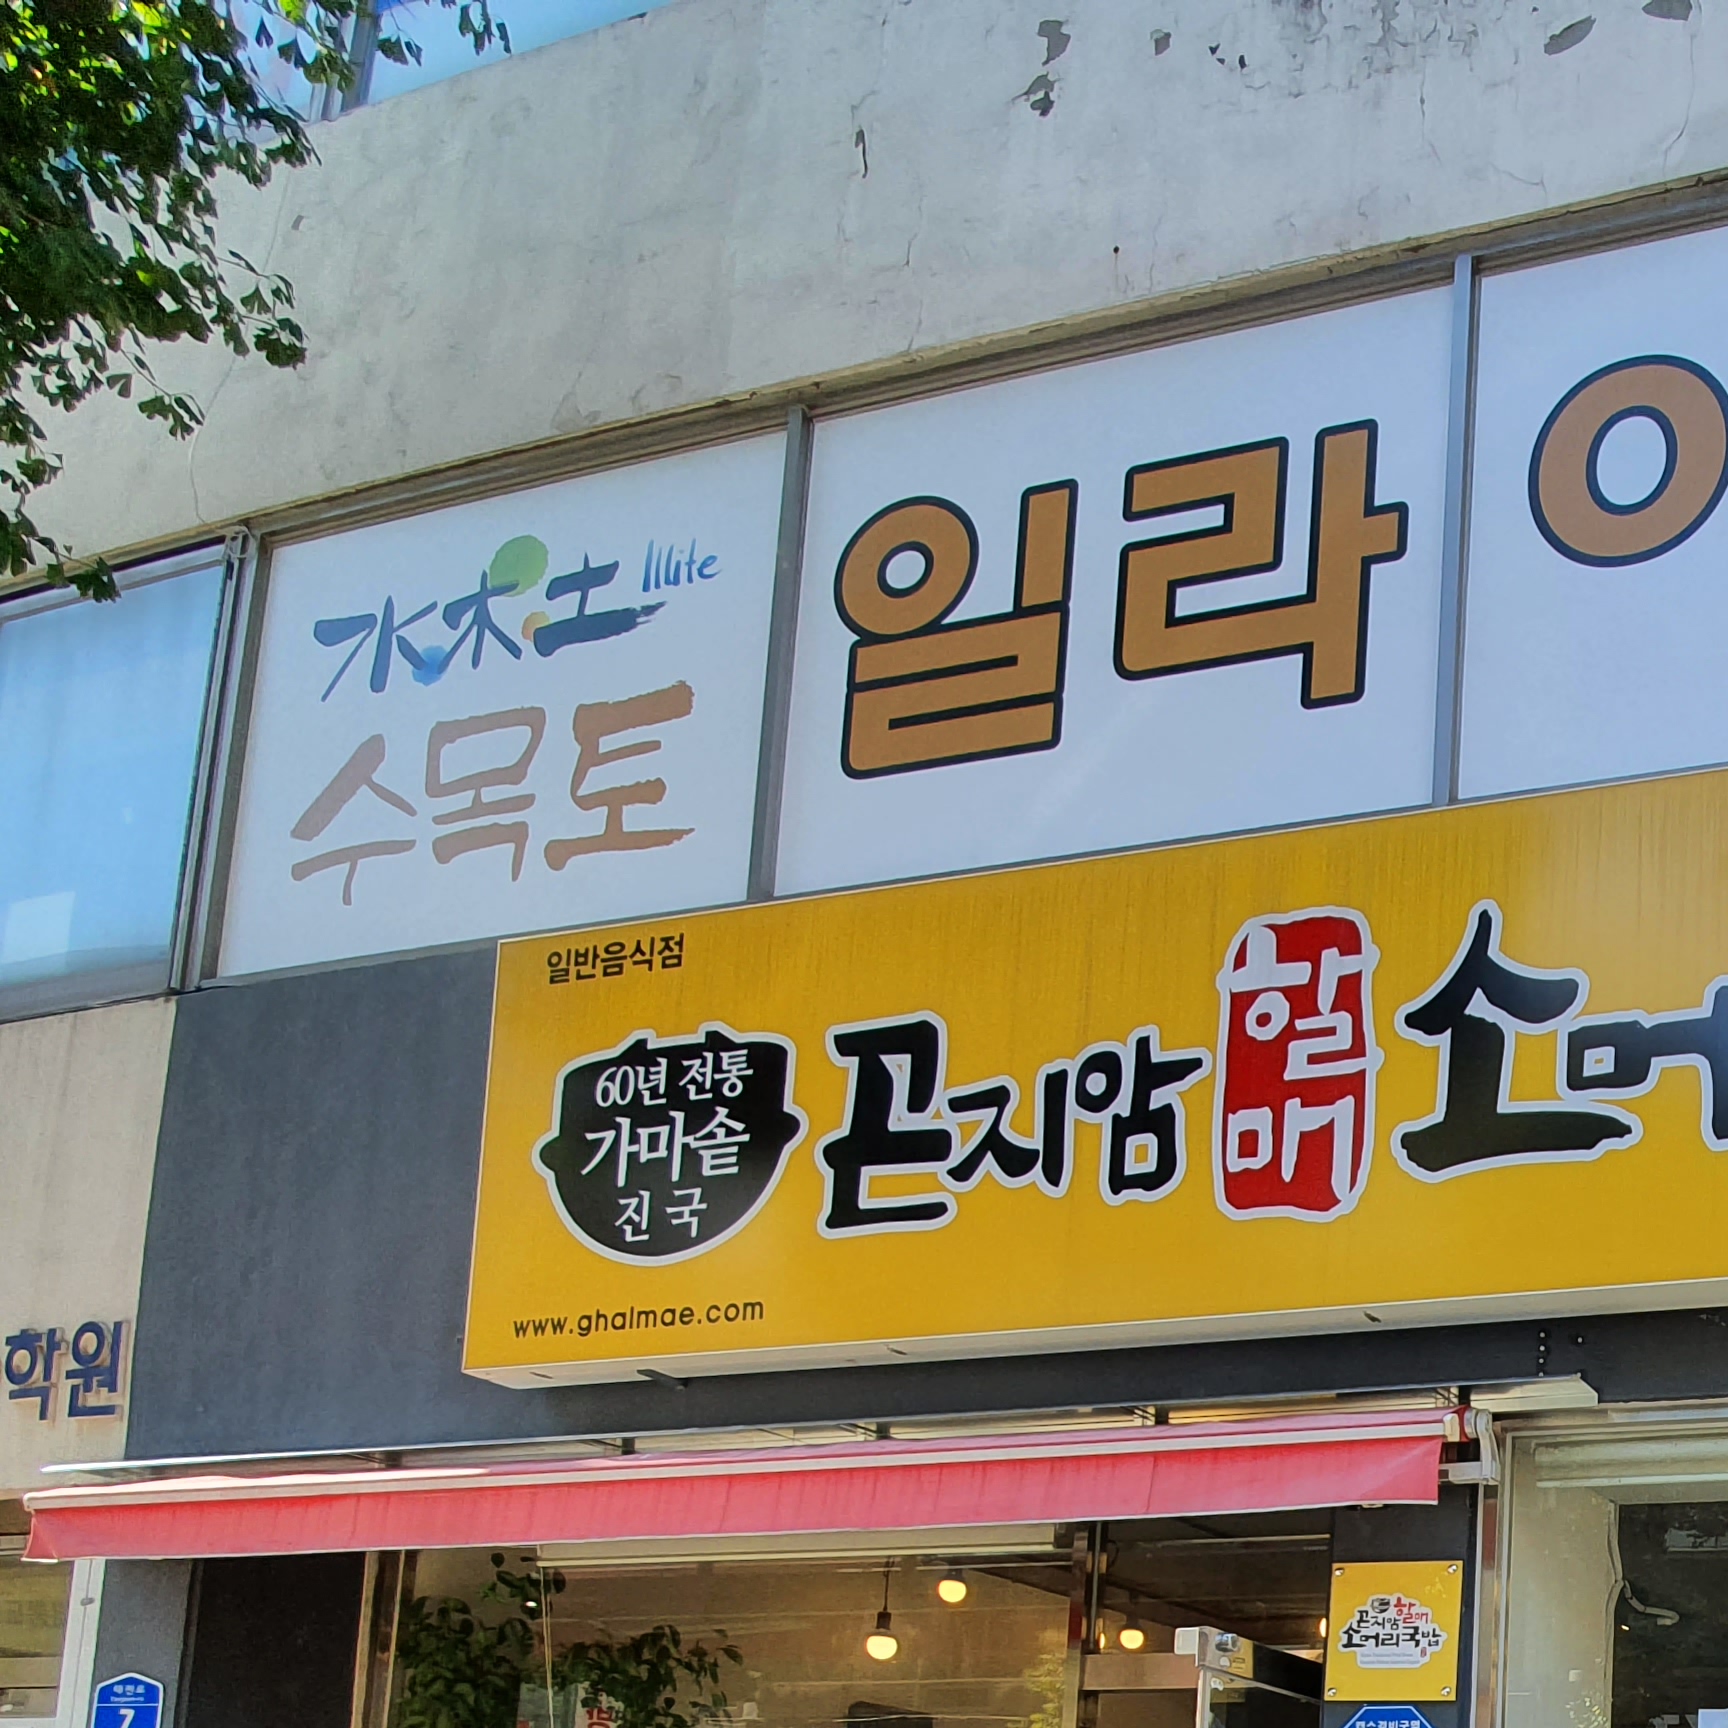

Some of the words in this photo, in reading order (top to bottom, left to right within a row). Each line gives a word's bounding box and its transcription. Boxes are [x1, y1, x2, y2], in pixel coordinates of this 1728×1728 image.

[289, 679, 697, 907] 수목토
[546, 932, 687, 987] 일반음식점
[594, 1054, 669, 1107] 60년
[679, 1045, 754, 1102] 전통
[818, 1016, 1206, 1232] 곤지암
[1222, 913, 1378, 1208] 할매
[580, 1106, 752, 1190] 가마솥
[512, 1296, 766, 1340] www.ghalmae.com
[4, 1319, 124, 1422] 학원
[1341, 1621, 1443, 1649] 소머리국밥
[1356, 1609, 1402, 1631] 곤지암
